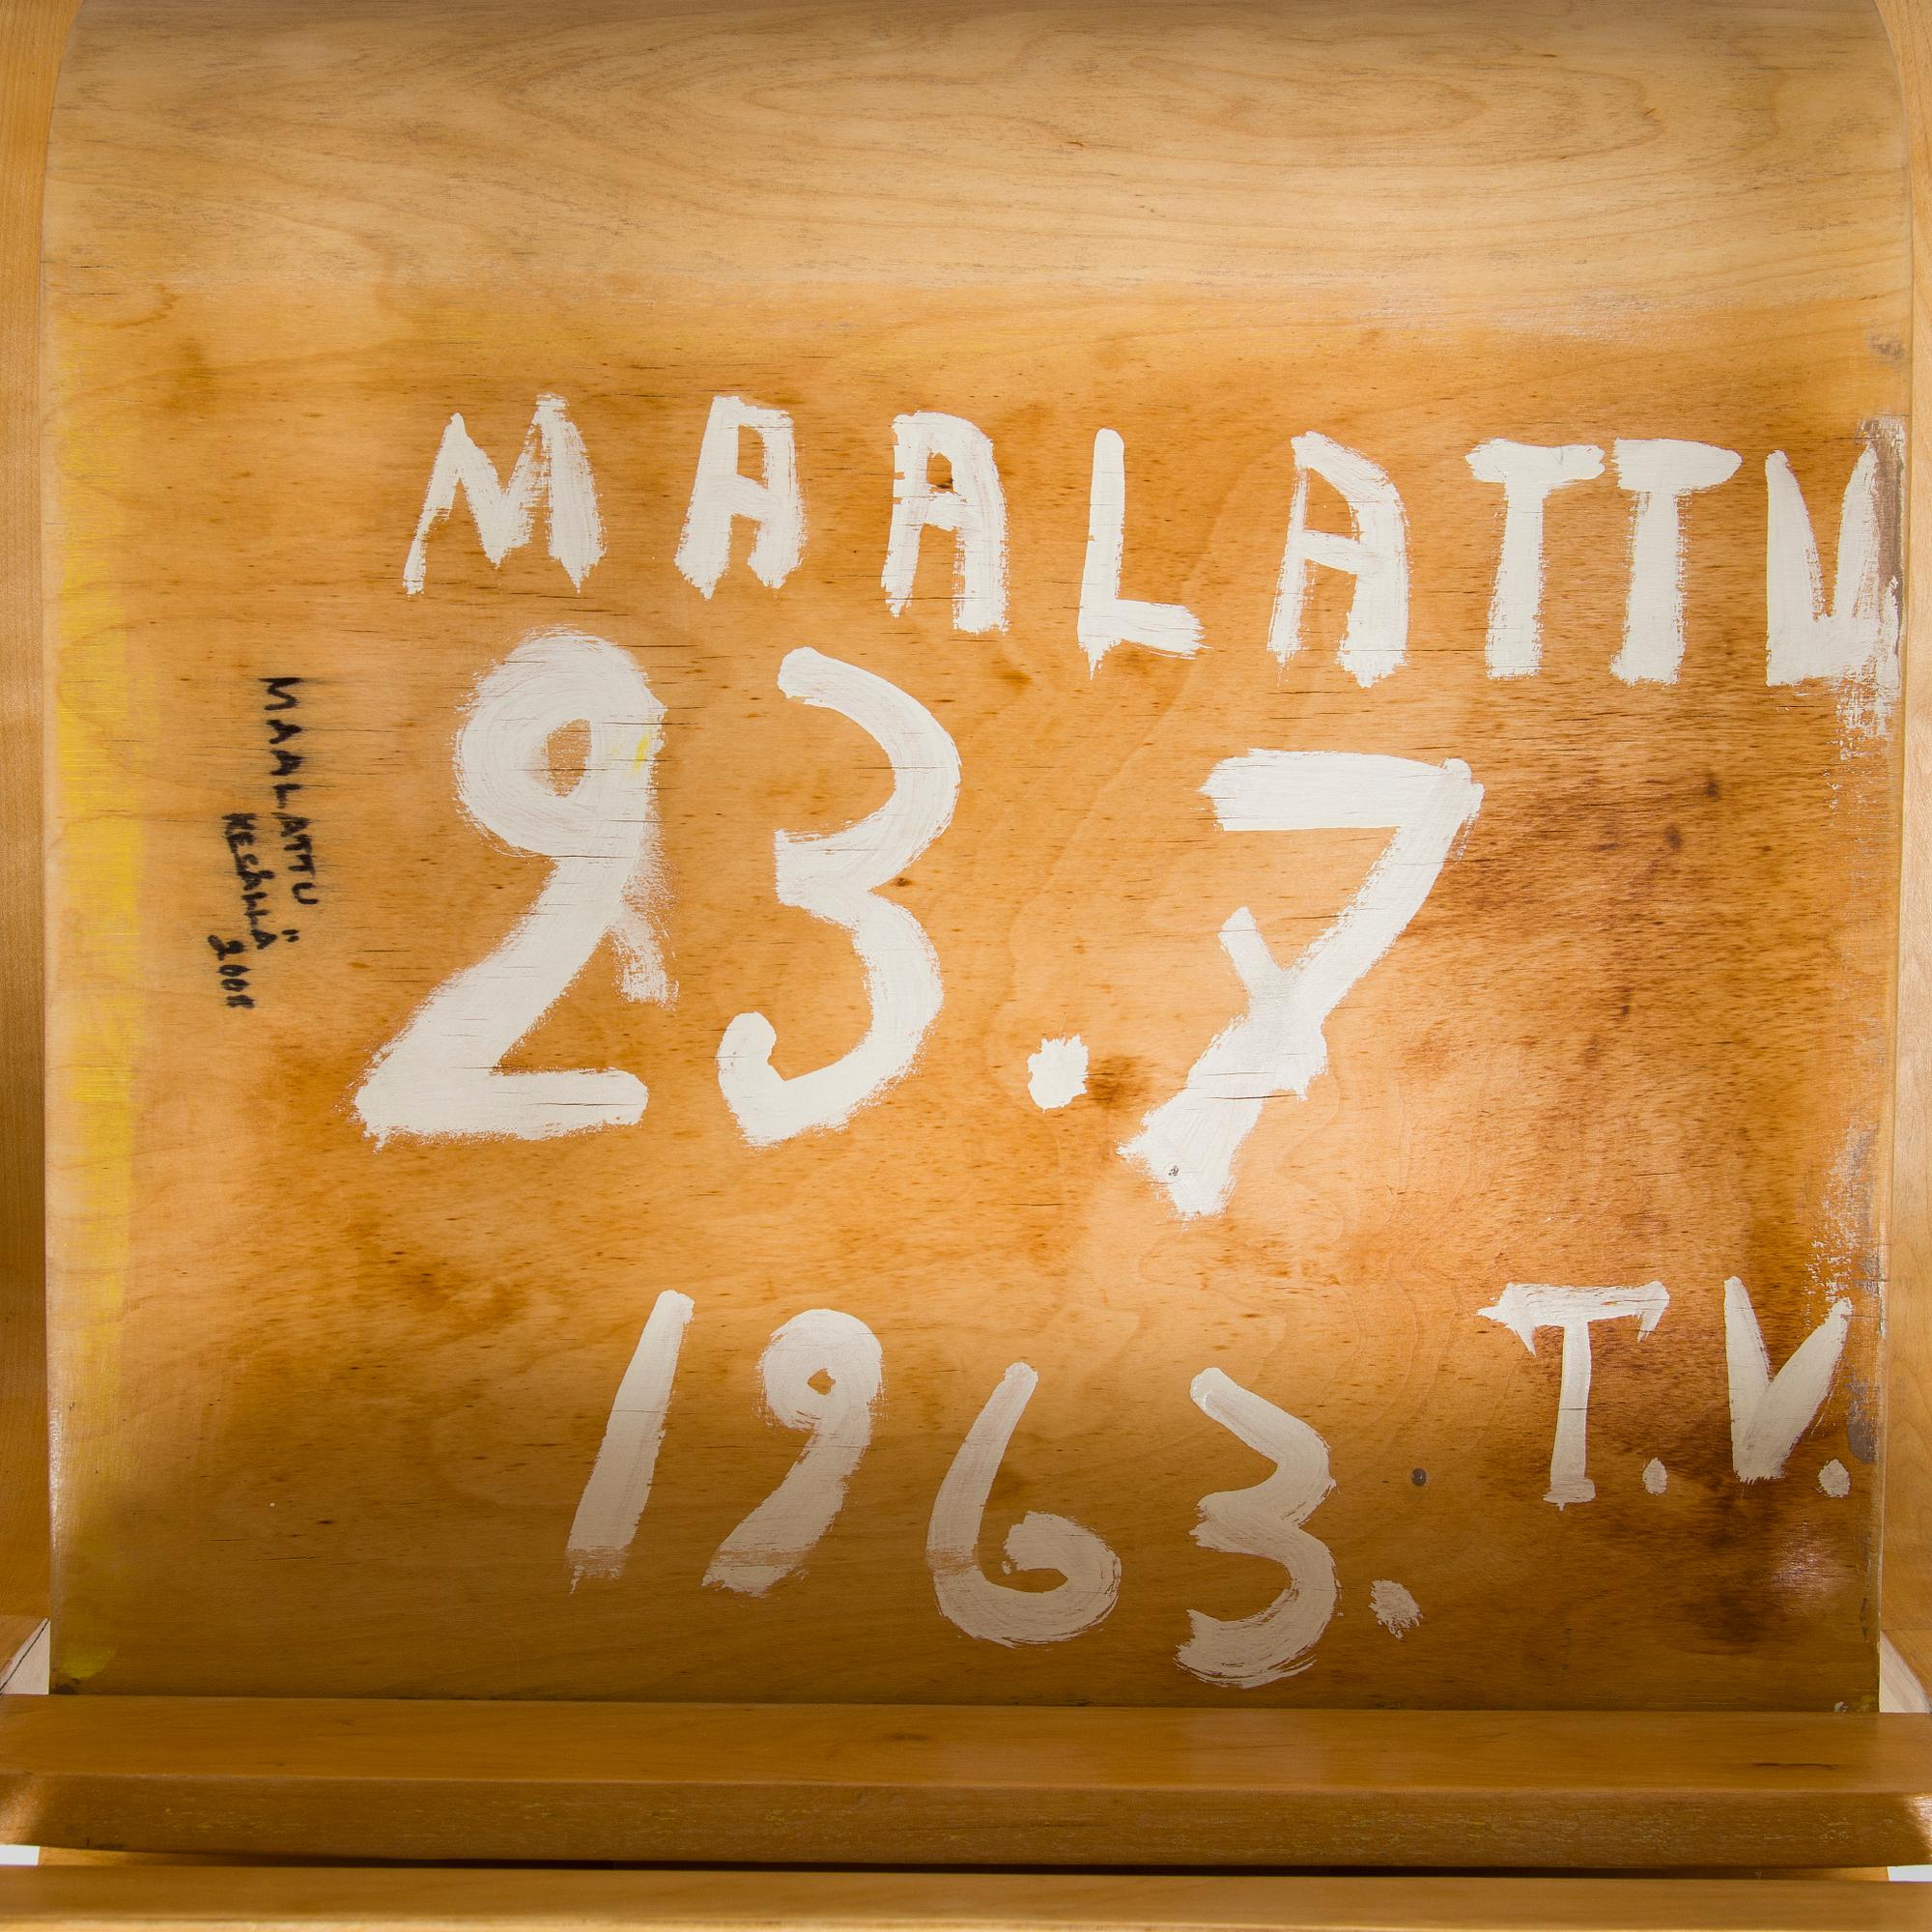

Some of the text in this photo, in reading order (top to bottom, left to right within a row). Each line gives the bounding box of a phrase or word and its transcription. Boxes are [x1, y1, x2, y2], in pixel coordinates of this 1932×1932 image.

[404, 394, 1901, 690] MAALATTU
[259, 677, 320, 904] MAALATTU
[567, 1289, 1422, 1689] 1963.
